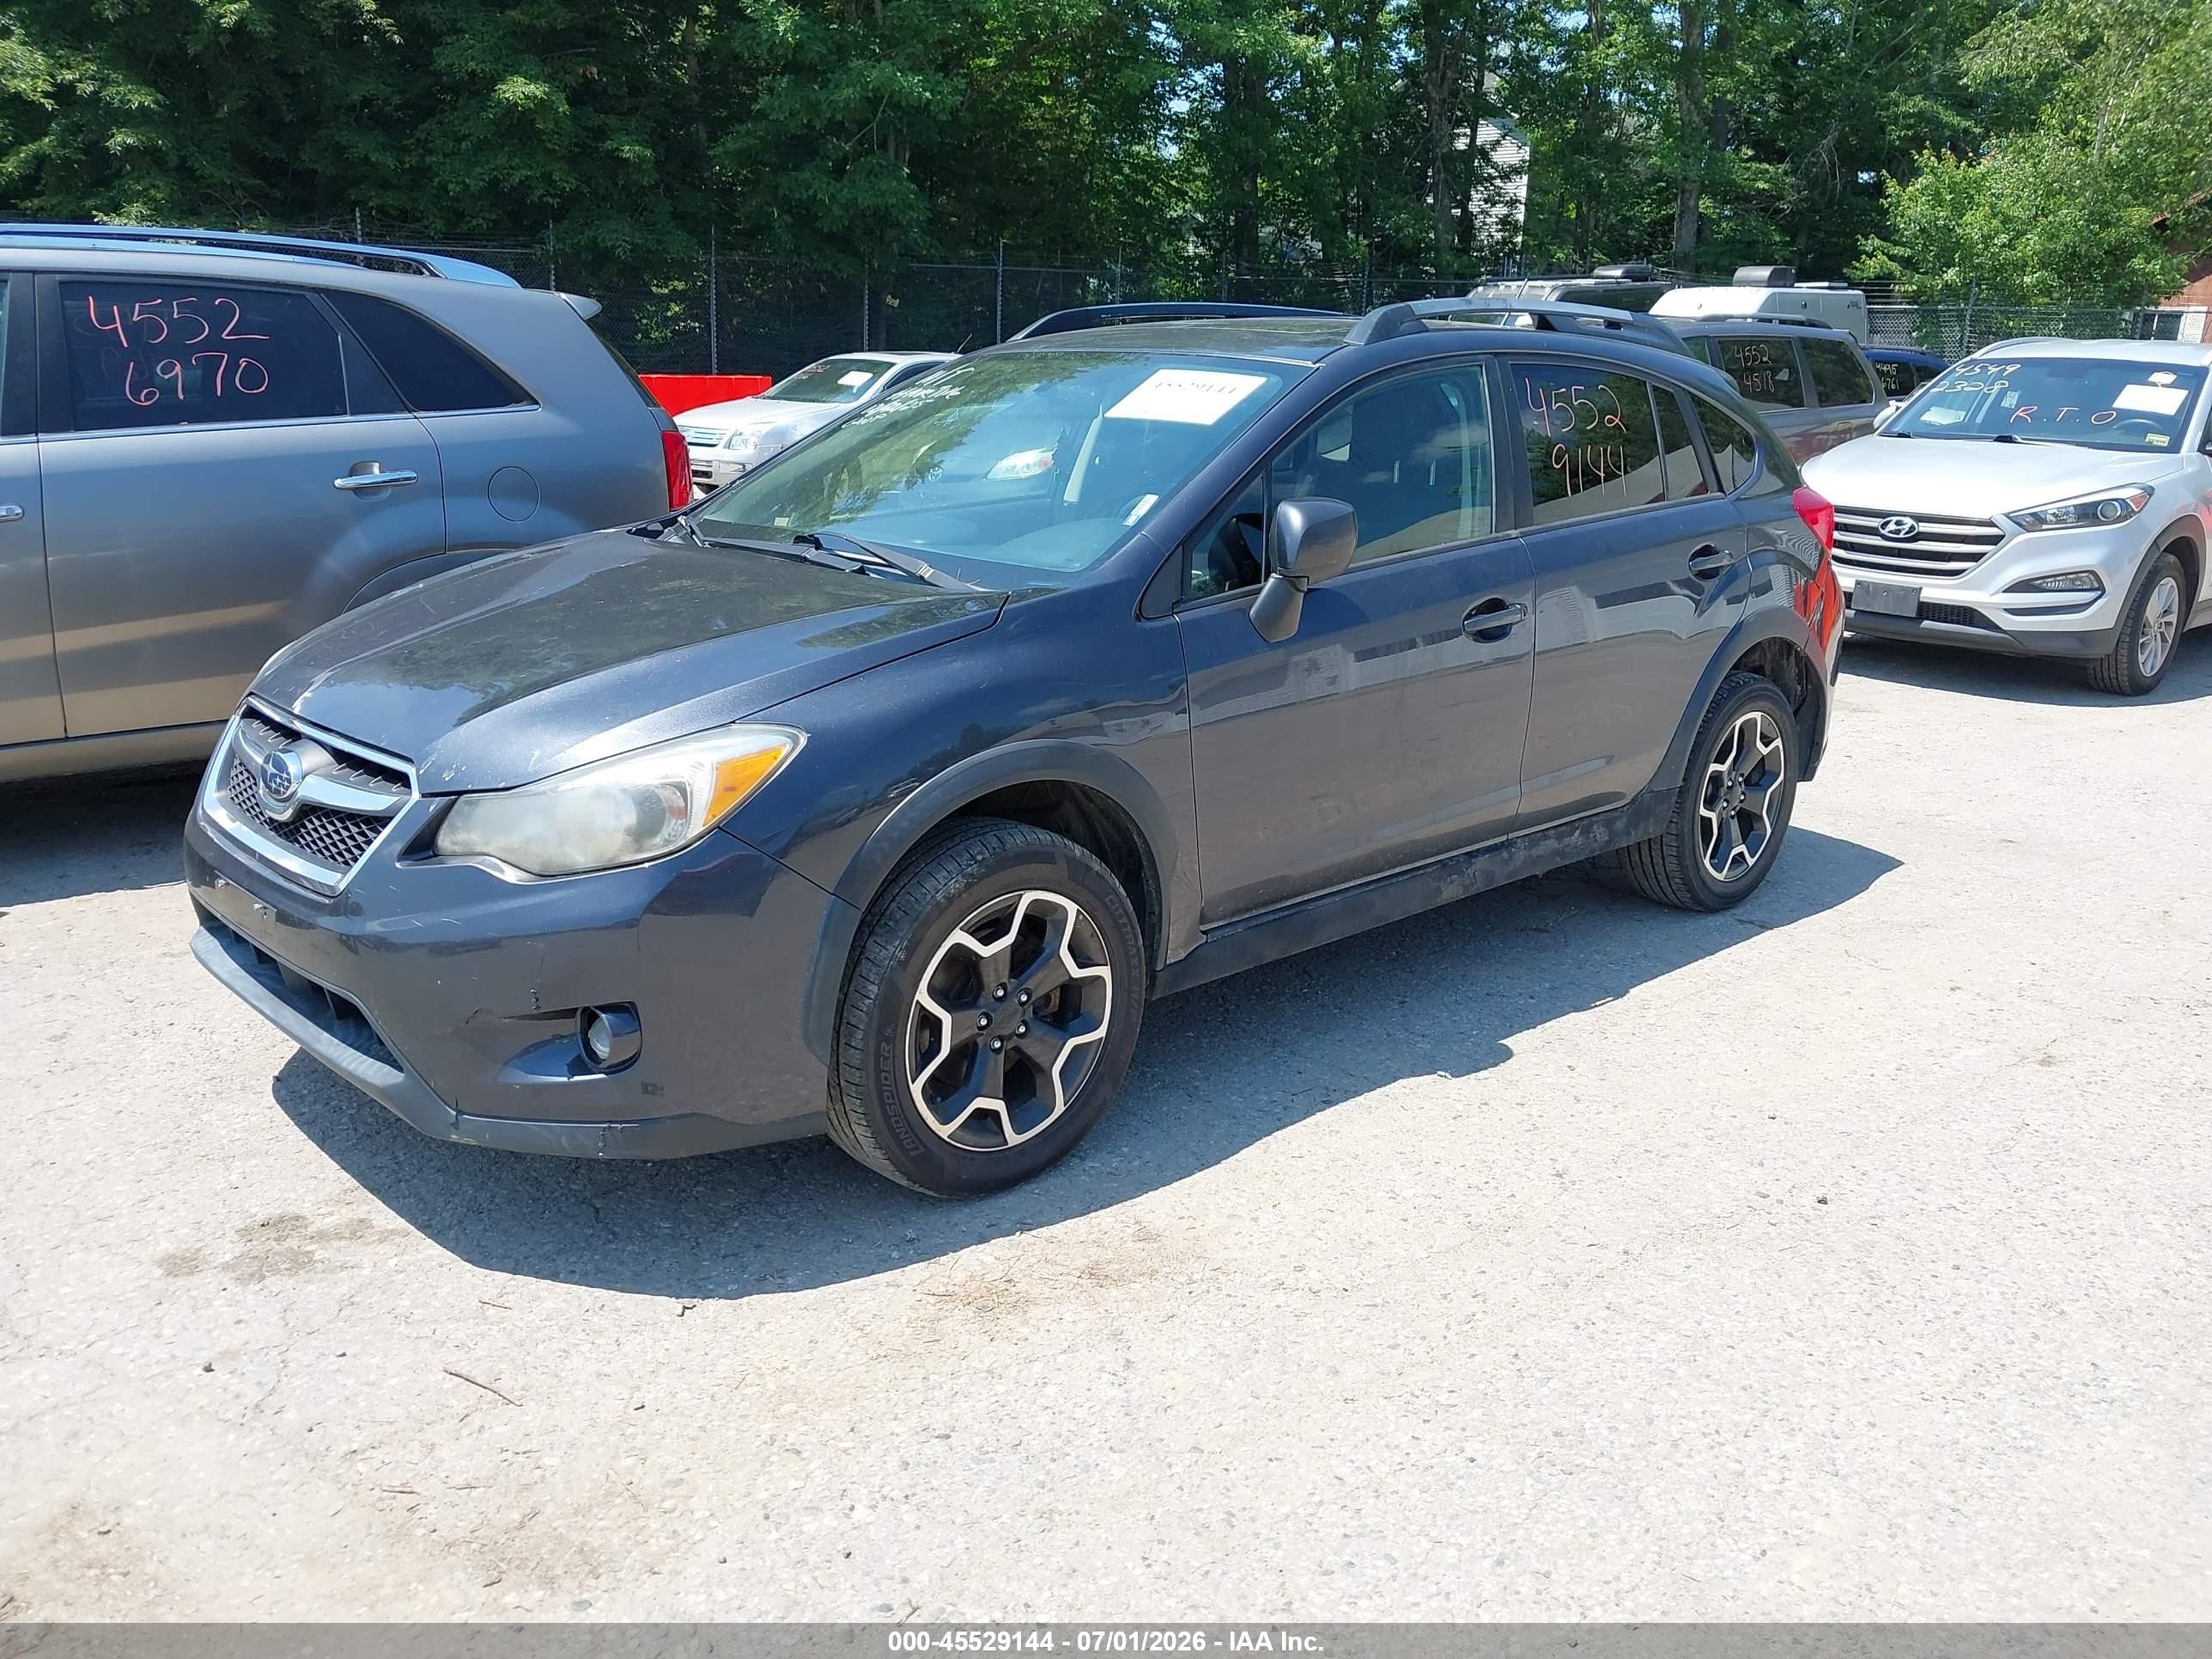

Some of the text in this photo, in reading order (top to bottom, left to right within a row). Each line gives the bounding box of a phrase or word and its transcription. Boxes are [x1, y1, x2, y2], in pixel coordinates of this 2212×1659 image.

[88, 295, 270, 349] 4552
[125, 351, 269, 406] 6970
[1734, 343, 1772, 368] 4552
[1742, 370, 1776, 393] 4518
[1524, 376, 1628, 439] 4552
[1552, 443, 1627, 498] 9144
[879, 1042, 926, 1156] LANDSPIDER
